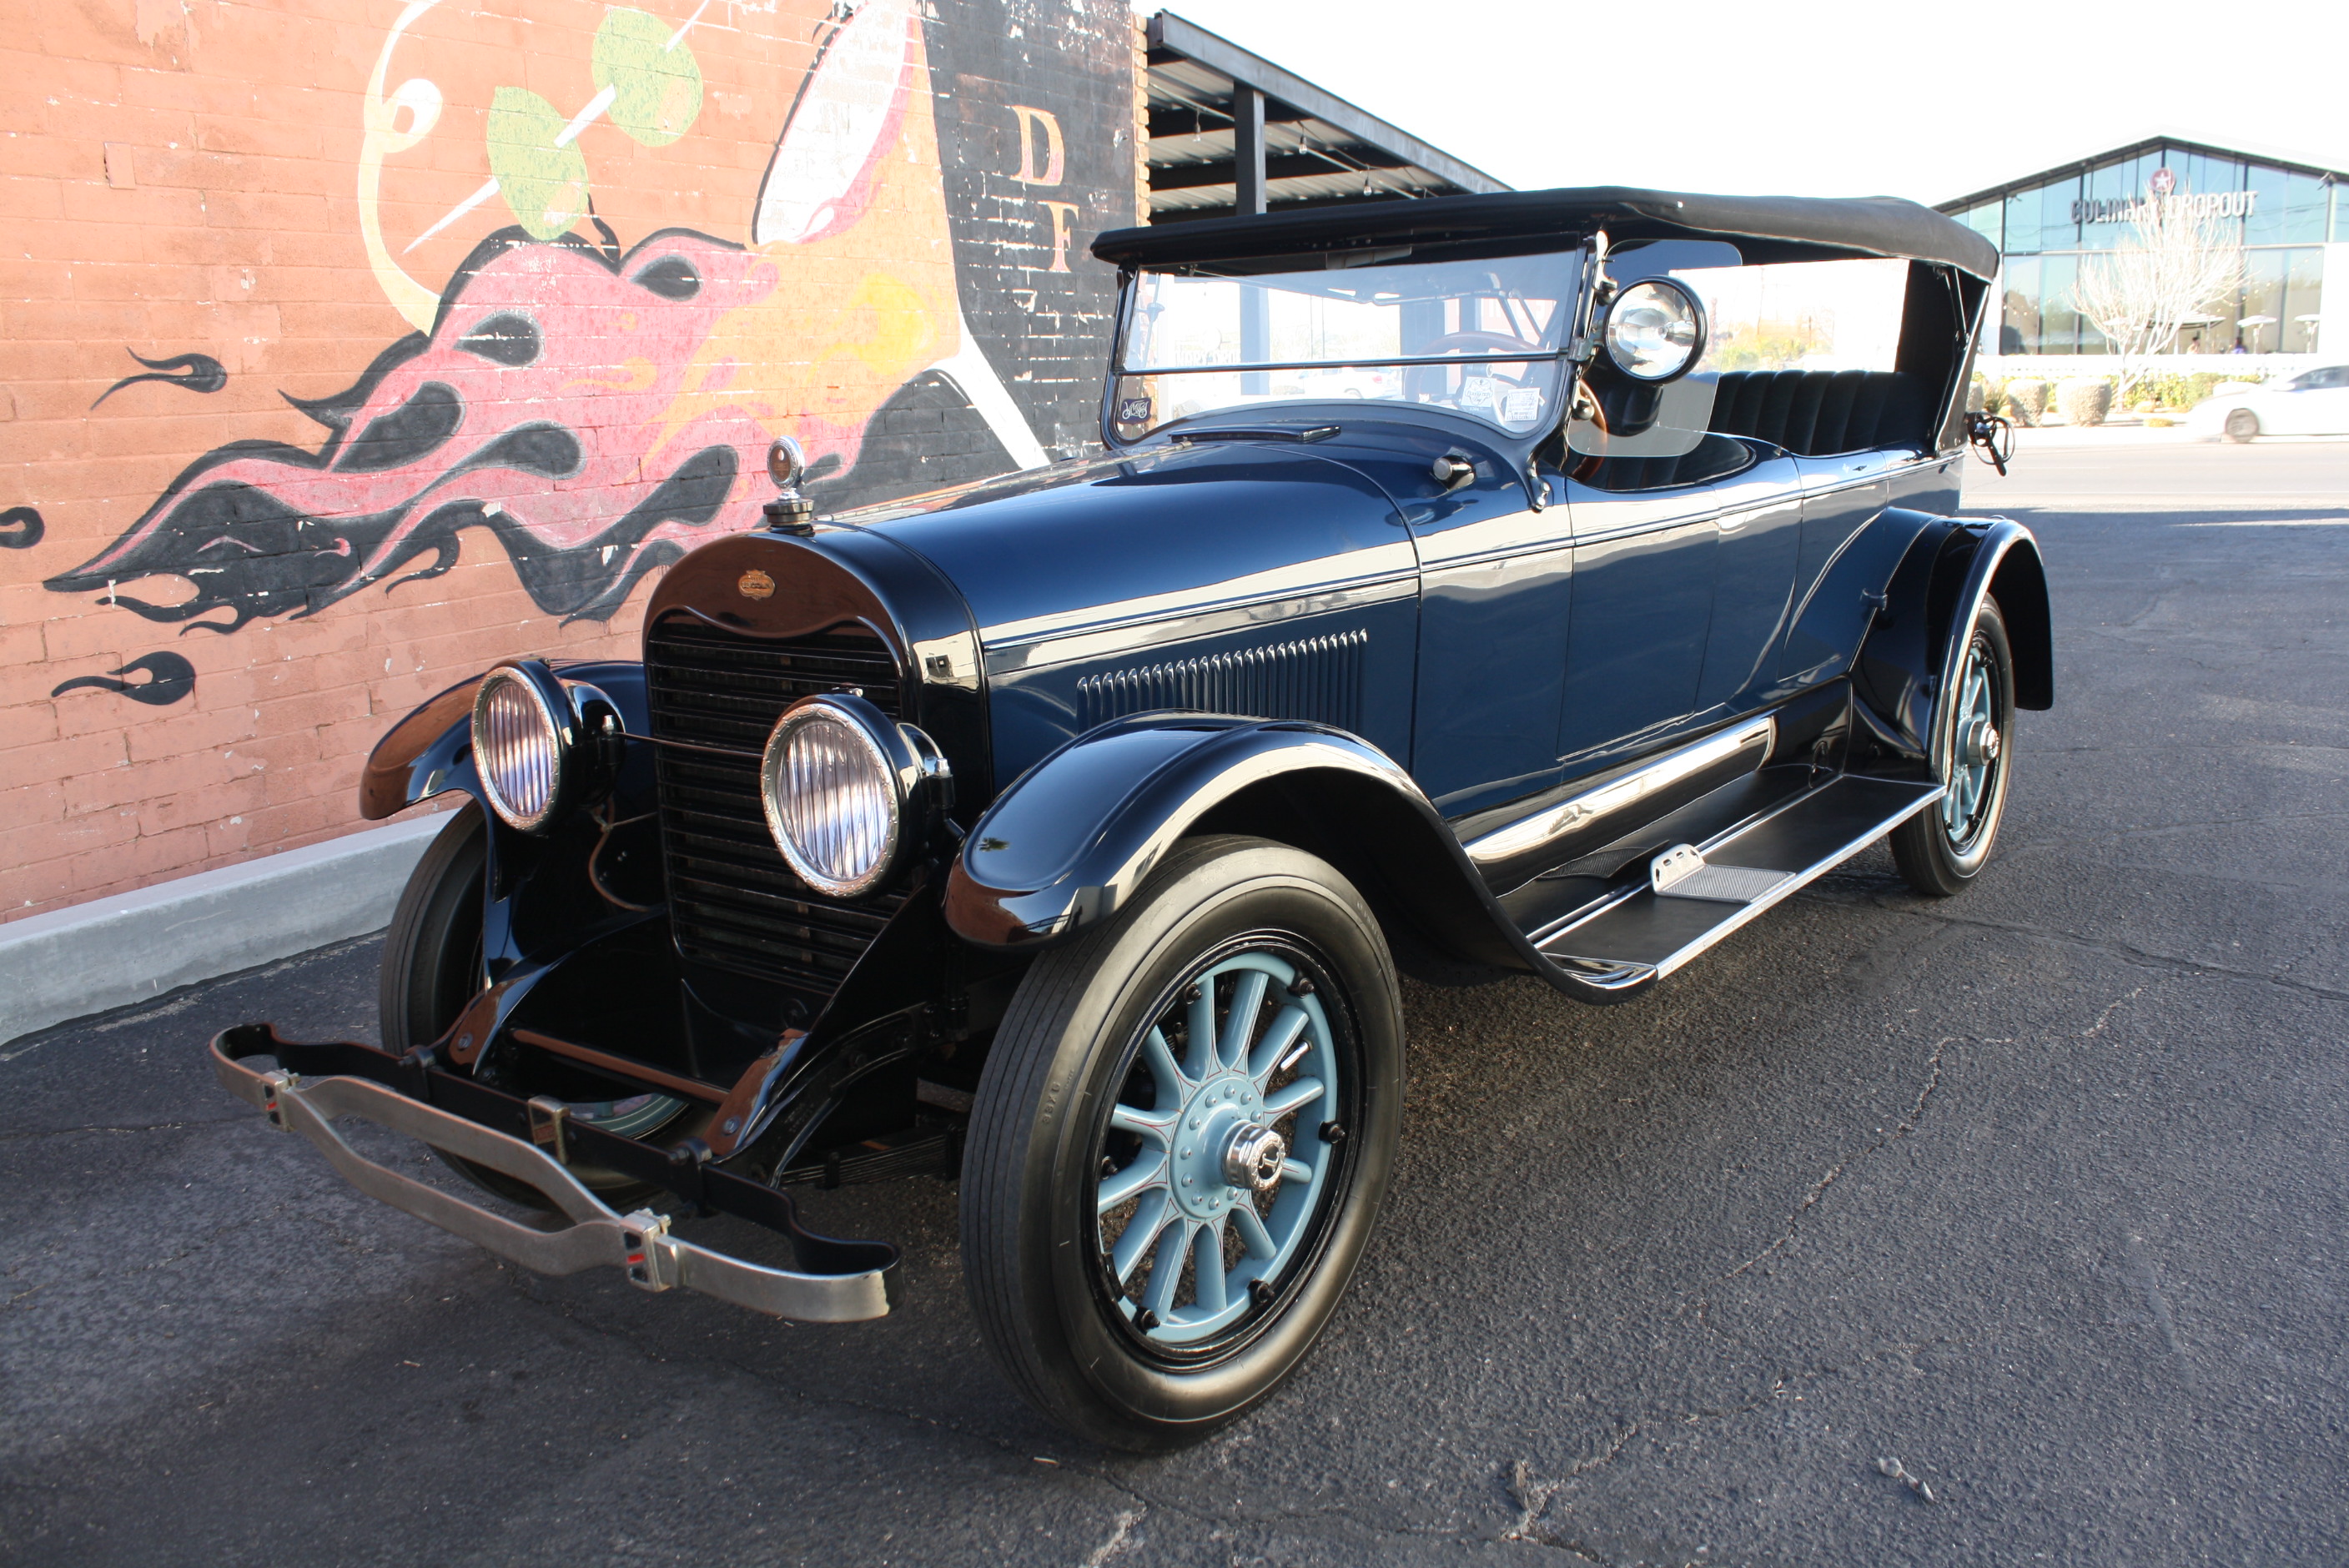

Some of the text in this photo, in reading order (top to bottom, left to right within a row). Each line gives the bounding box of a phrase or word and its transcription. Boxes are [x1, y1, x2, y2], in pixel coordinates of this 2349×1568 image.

[1009, 105, 1064, 186] D
[1047, 200, 1079, 274] F
[2169, 190, 2259, 219] DROPOUT
